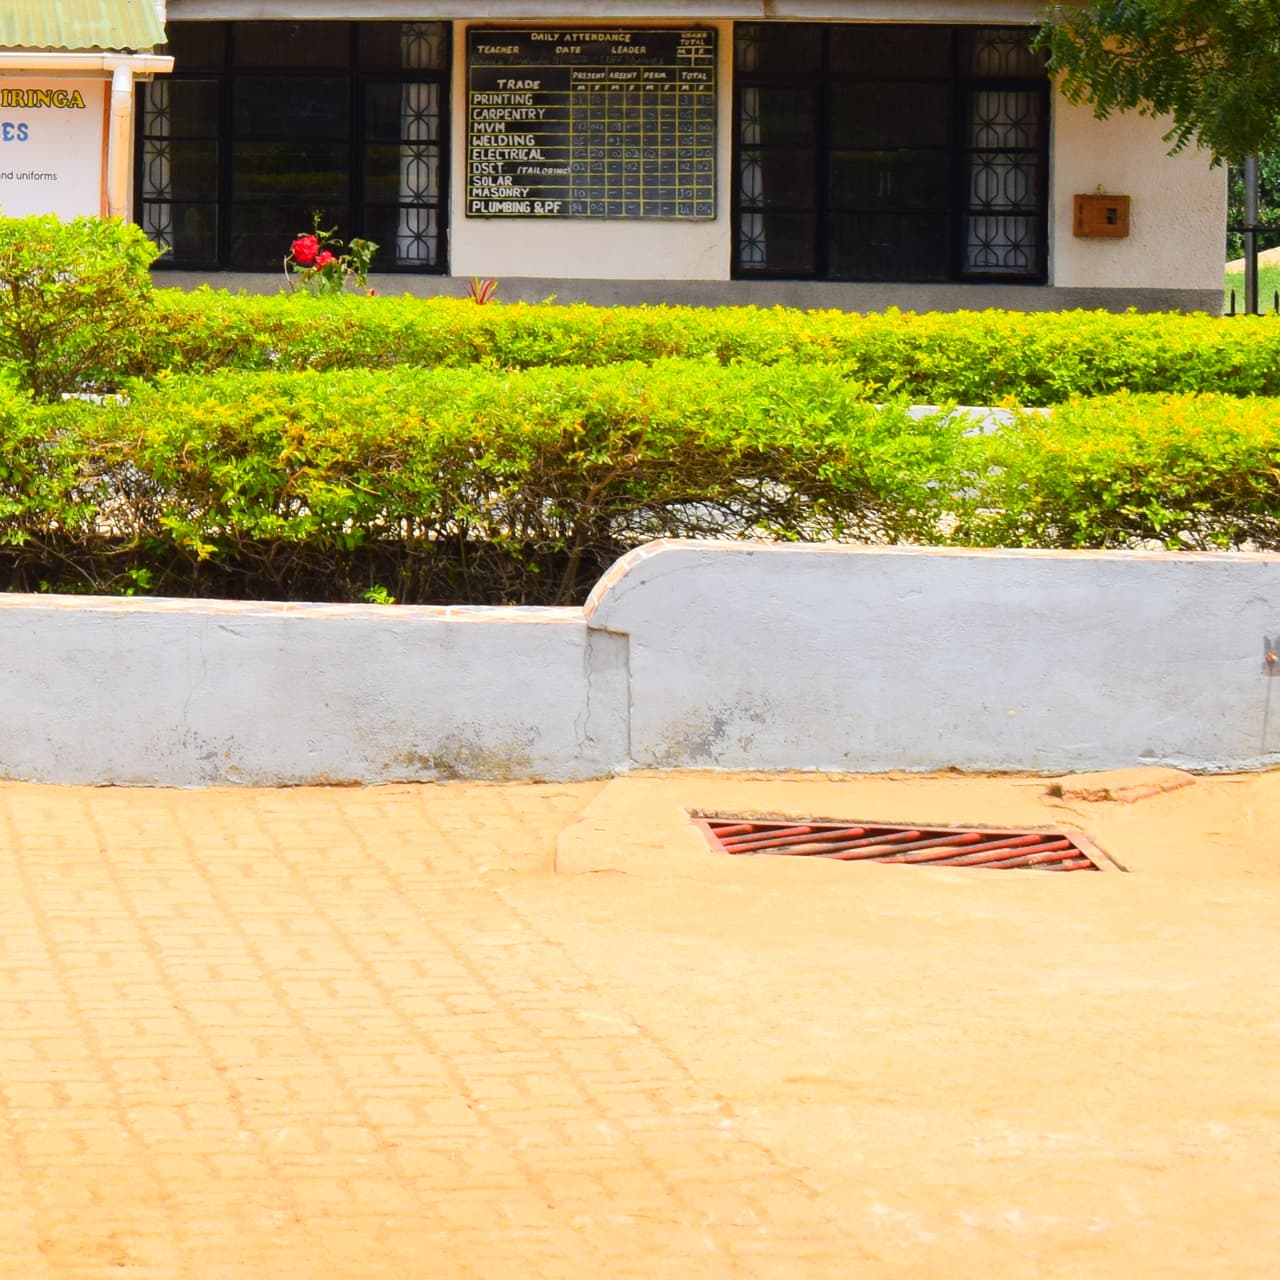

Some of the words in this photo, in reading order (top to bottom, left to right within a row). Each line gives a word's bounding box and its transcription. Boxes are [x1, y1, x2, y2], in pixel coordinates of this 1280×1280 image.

[531, 32, 560, 41] DAILY
[564, 33, 632, 43] ATTENDANCE
[476, 45, 520, 54] TEACHER
[556, 46, 582, 54] DATE
[611, 46, 647, 54] LEADER
[682, 72, 707, 80] TOTAL
[496, 80, 542, 89] TRADE
[0, 89, 86, 109] IRINGA
[473, 94, 534, 105] PRINTING
[473, 108, 546, 120] CARPENTRY
[474, 122, 506, 133] MVM
[472, 135, 536, 146] WELDING
[472, 149, 546, 160] ELECTRICAL
[473, 163, 504, 174] DSCT
[16, 170, 58, 181] uniforms
[472, 176, 513, 186] SOLAR
[472, 188, 529, 198] MASONRY
[472, 201, 531, 213] PLUMBING
